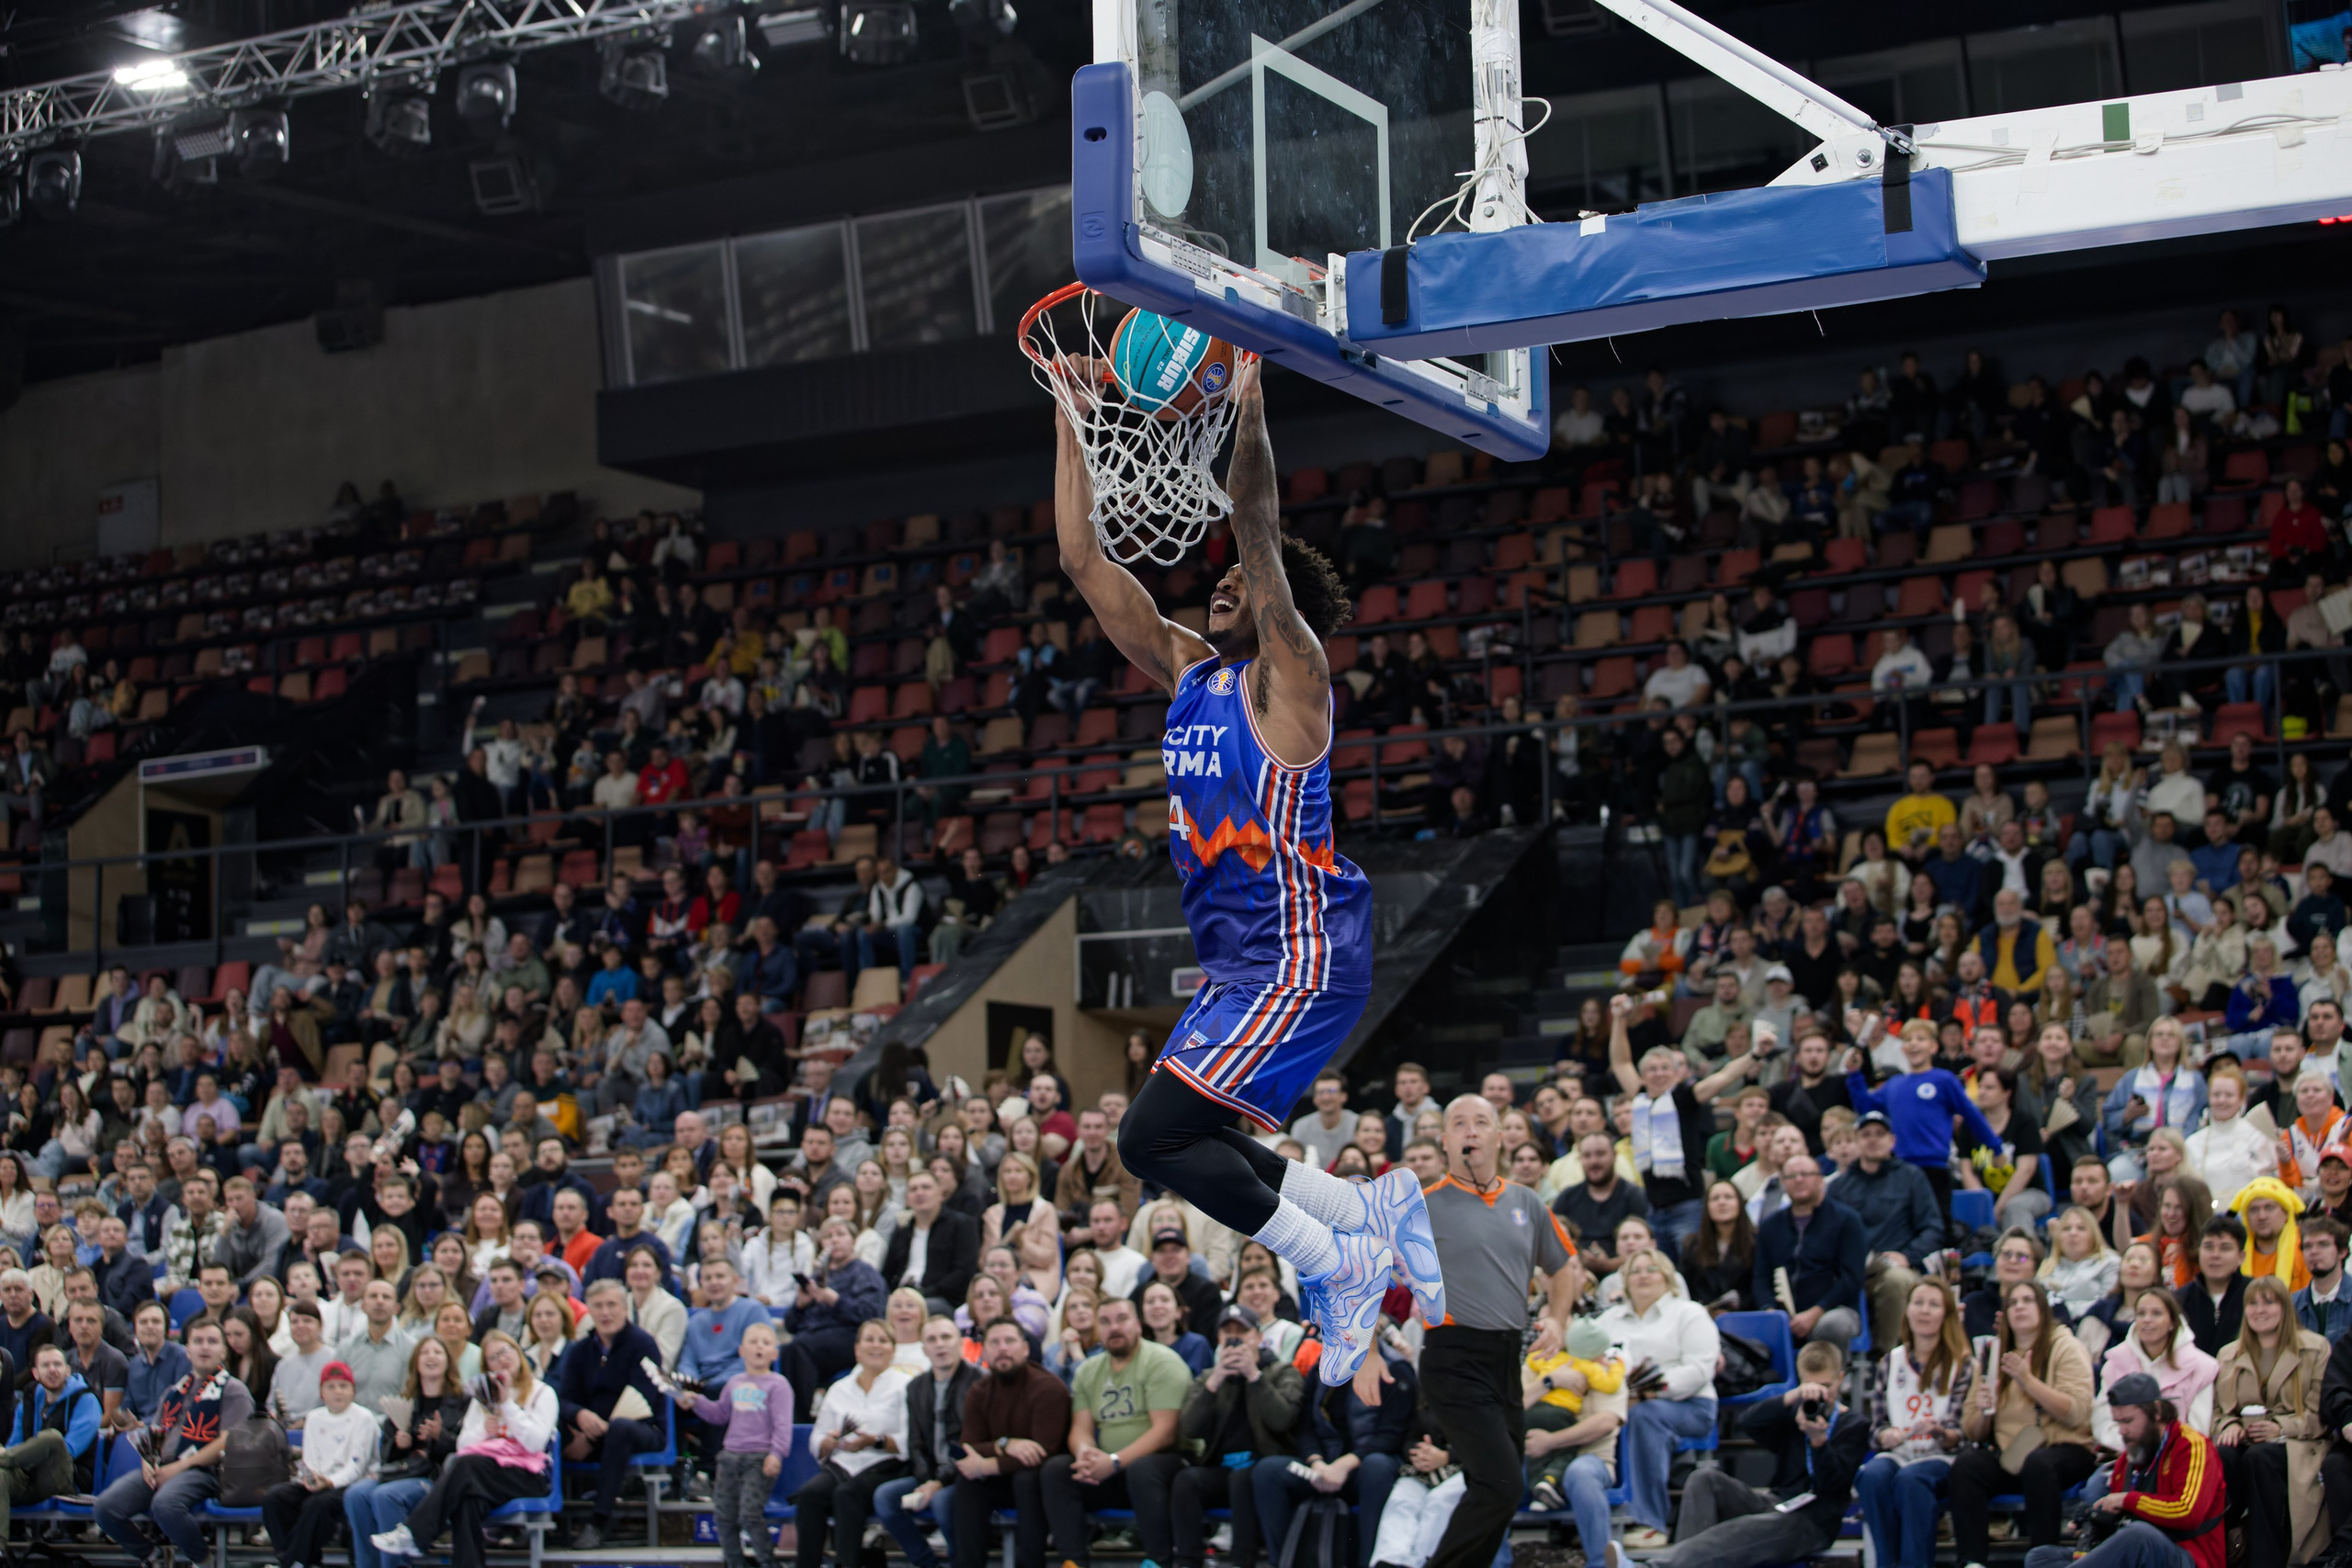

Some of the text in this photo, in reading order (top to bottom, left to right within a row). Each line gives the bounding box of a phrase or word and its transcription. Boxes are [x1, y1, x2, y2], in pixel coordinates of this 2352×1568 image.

[1157, 326, 1201, 392] SIBUR
[1169, 795, 1191, 841] 4
[1100, 1385, 1135, 1420] 23
